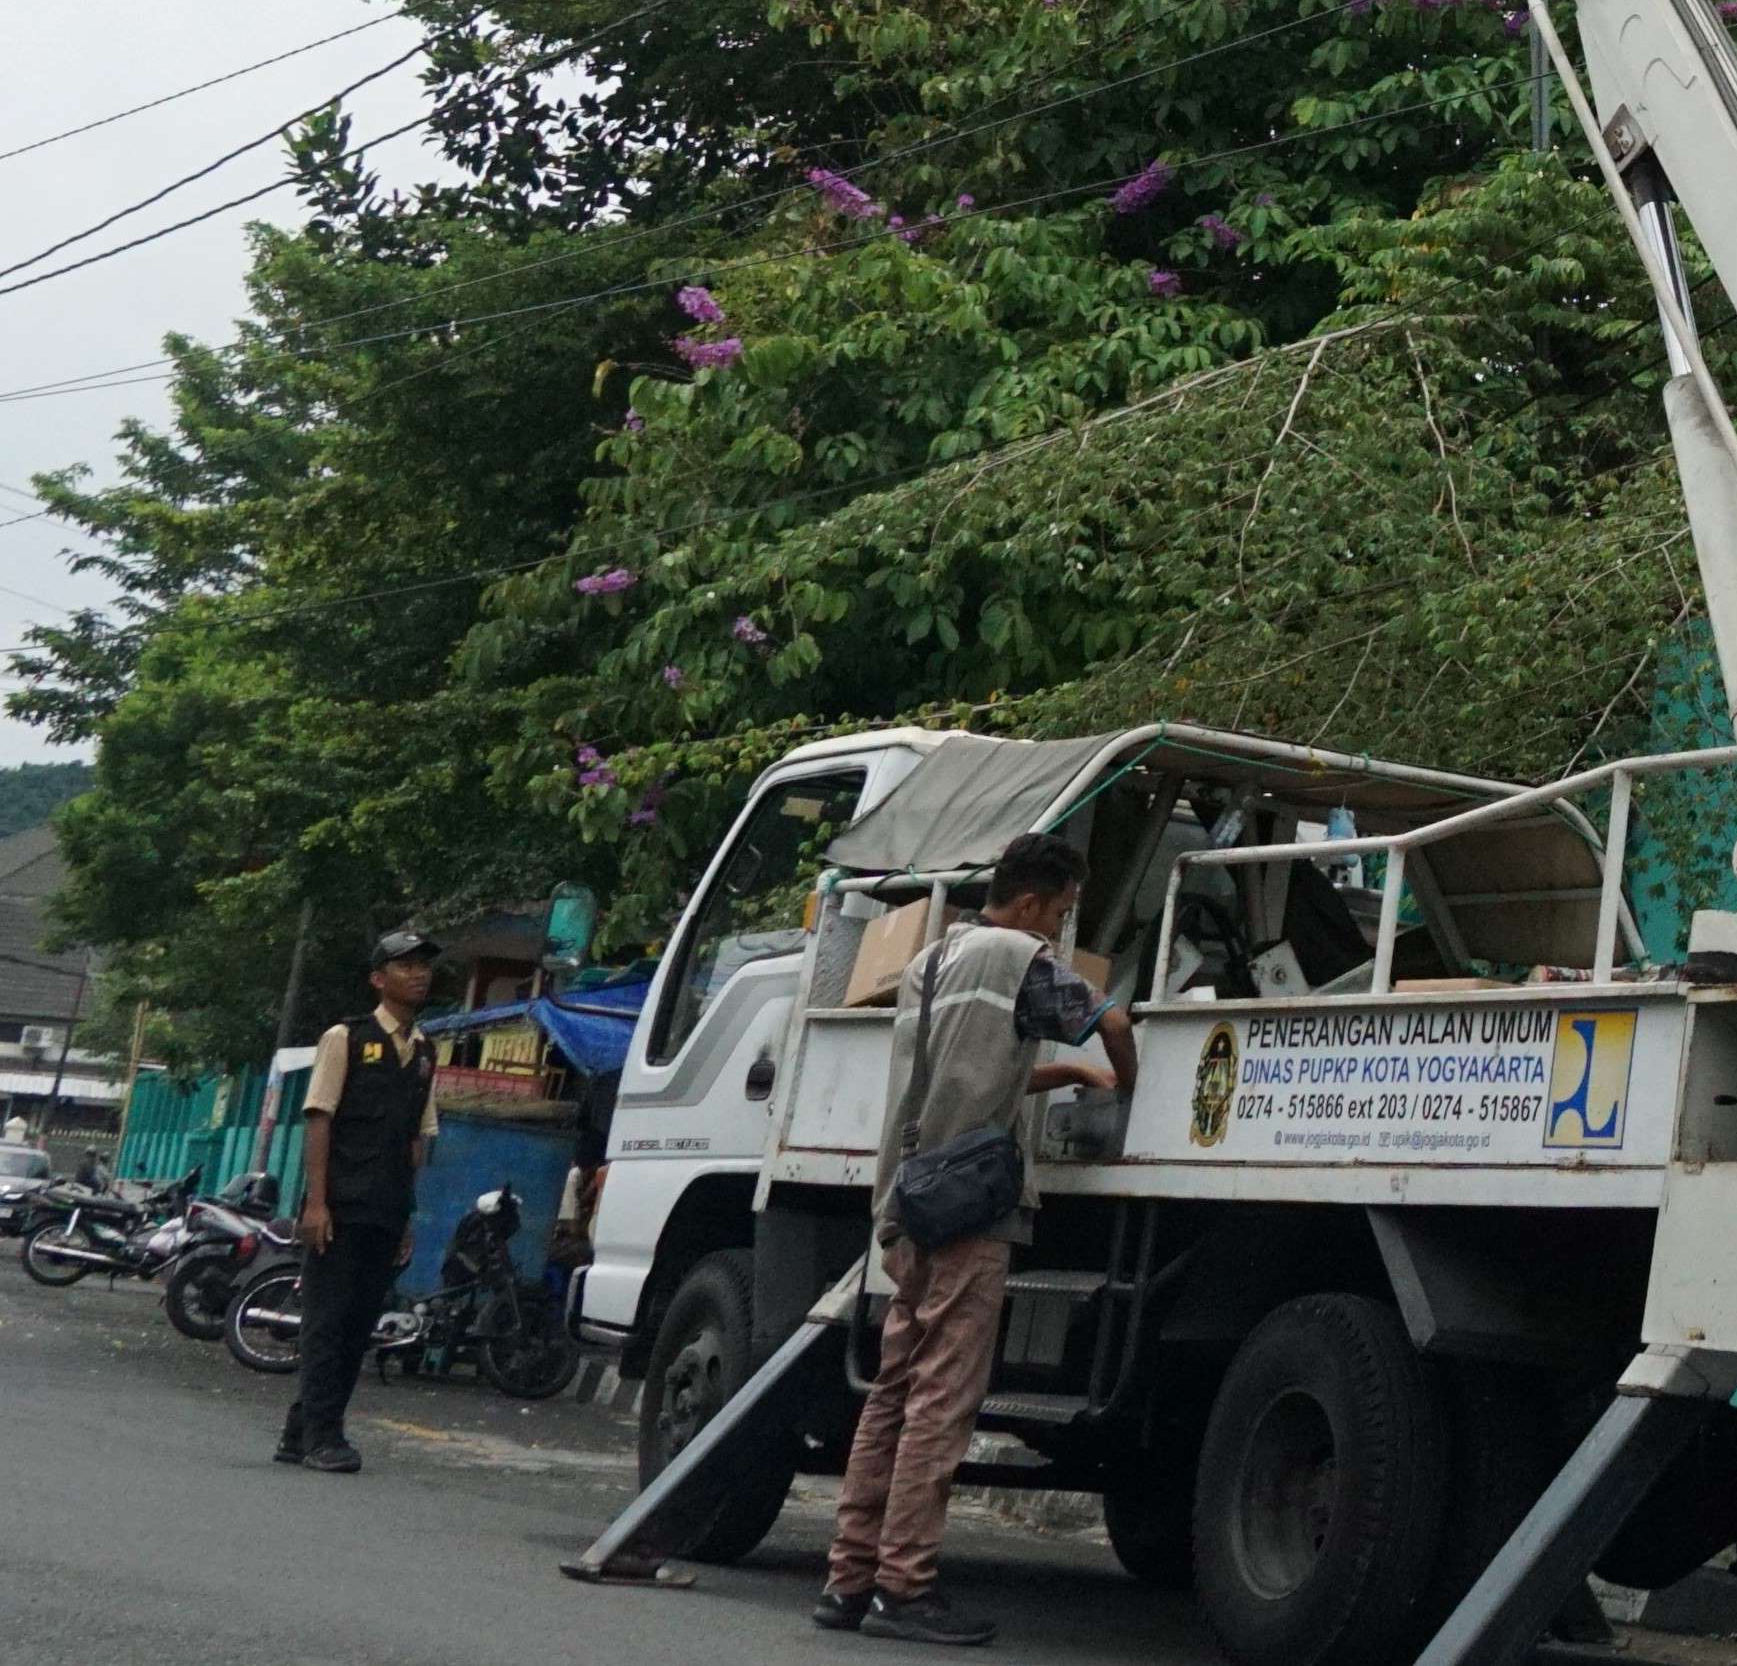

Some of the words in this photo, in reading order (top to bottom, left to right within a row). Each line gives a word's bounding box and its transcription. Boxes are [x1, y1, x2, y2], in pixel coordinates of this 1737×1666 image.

[1246, 1014, 1394, 1049] PENERANGAN
[1399, 1011, 1474, 1045] JALAN
[1481, 1010, 1553, 1044] UMUM
[1242, 1058, 1294, 1084] DINAS
[1298, 1057, 1358, 1083] PUPKP
[1361, 1056, 1410, 1083] KOTA
[1417, 1055, 1545, 1084] YOGYAKARTA
[1237, 1094, 1274, 1120] 0274
[1288, 1094, 1345, 1119] 515866
[1348, 1095, 1374, 1119] ext
[1377, 1094, 1407, 1119] 203
[1411, 1094, 1419, 1119] /
[1422, 1093, 1463, 1120] 0274
[1479, 1094, 1543, 1121] 515867
